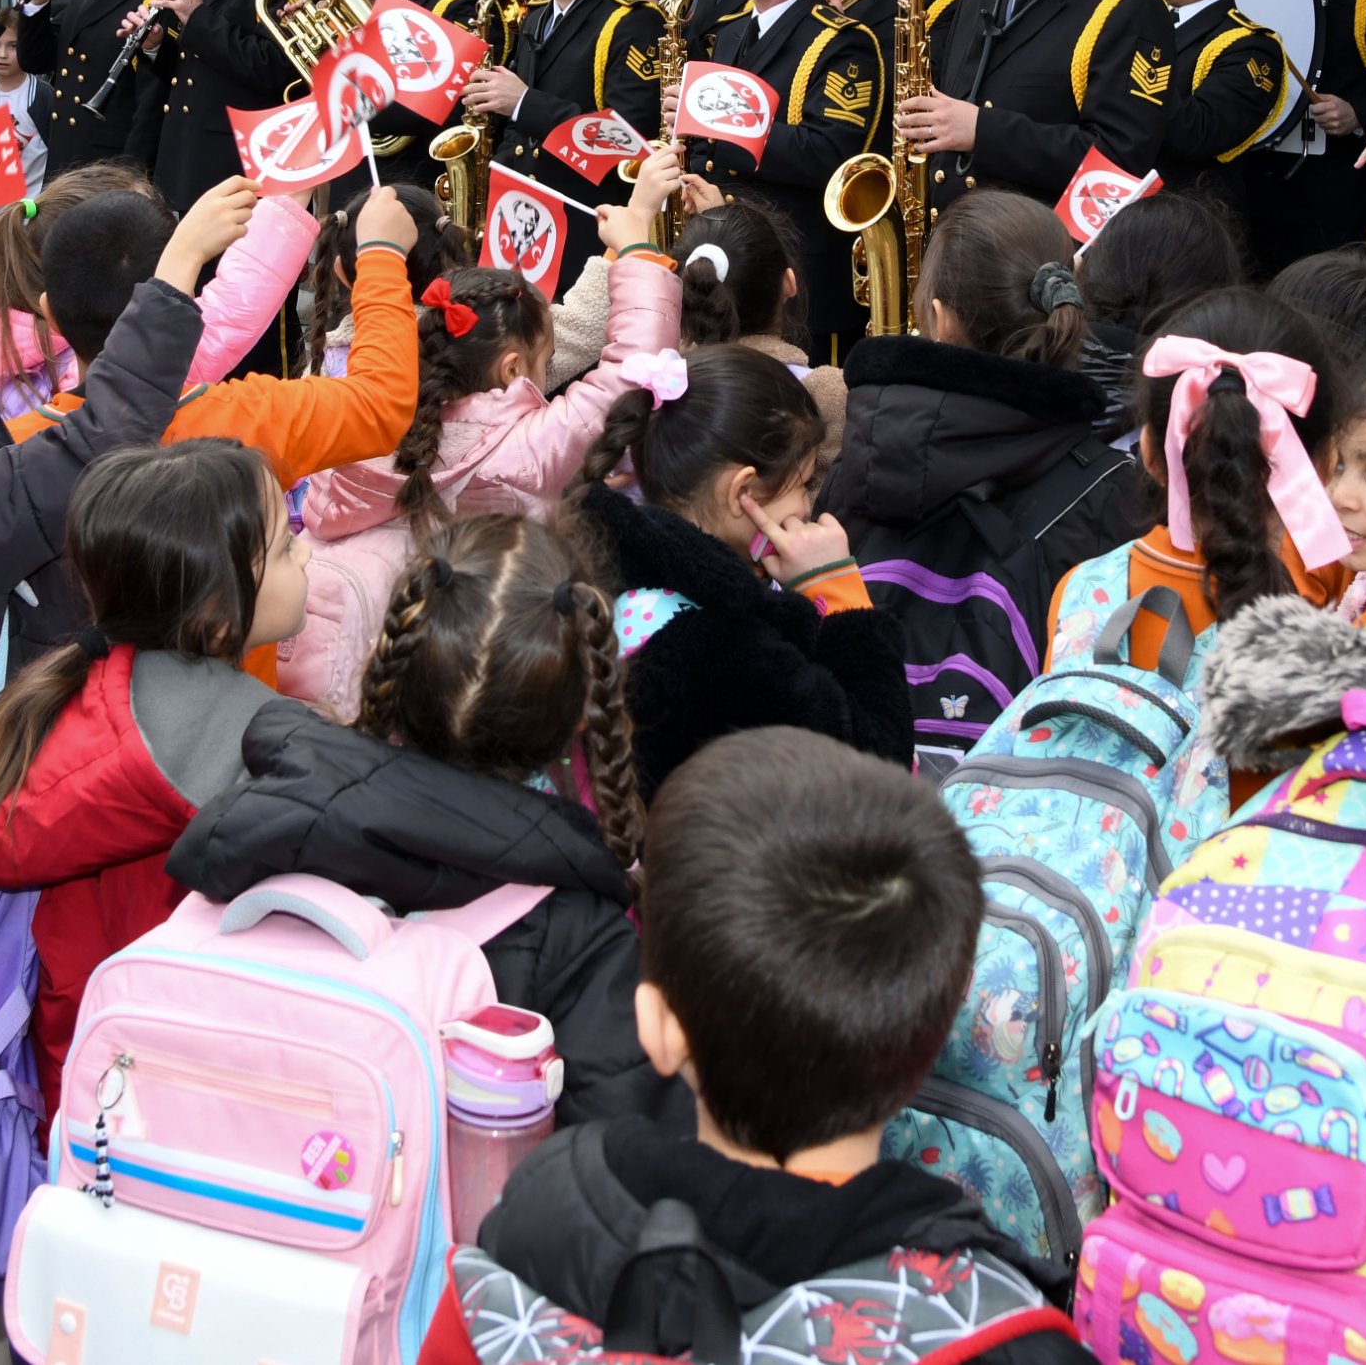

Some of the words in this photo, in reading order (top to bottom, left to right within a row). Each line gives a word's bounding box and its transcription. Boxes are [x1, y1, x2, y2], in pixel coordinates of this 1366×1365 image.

[444, 60, 475, 101] ATA
[0, 127, 18, 174] ATA
[559, 145, 588, 171] ATA
